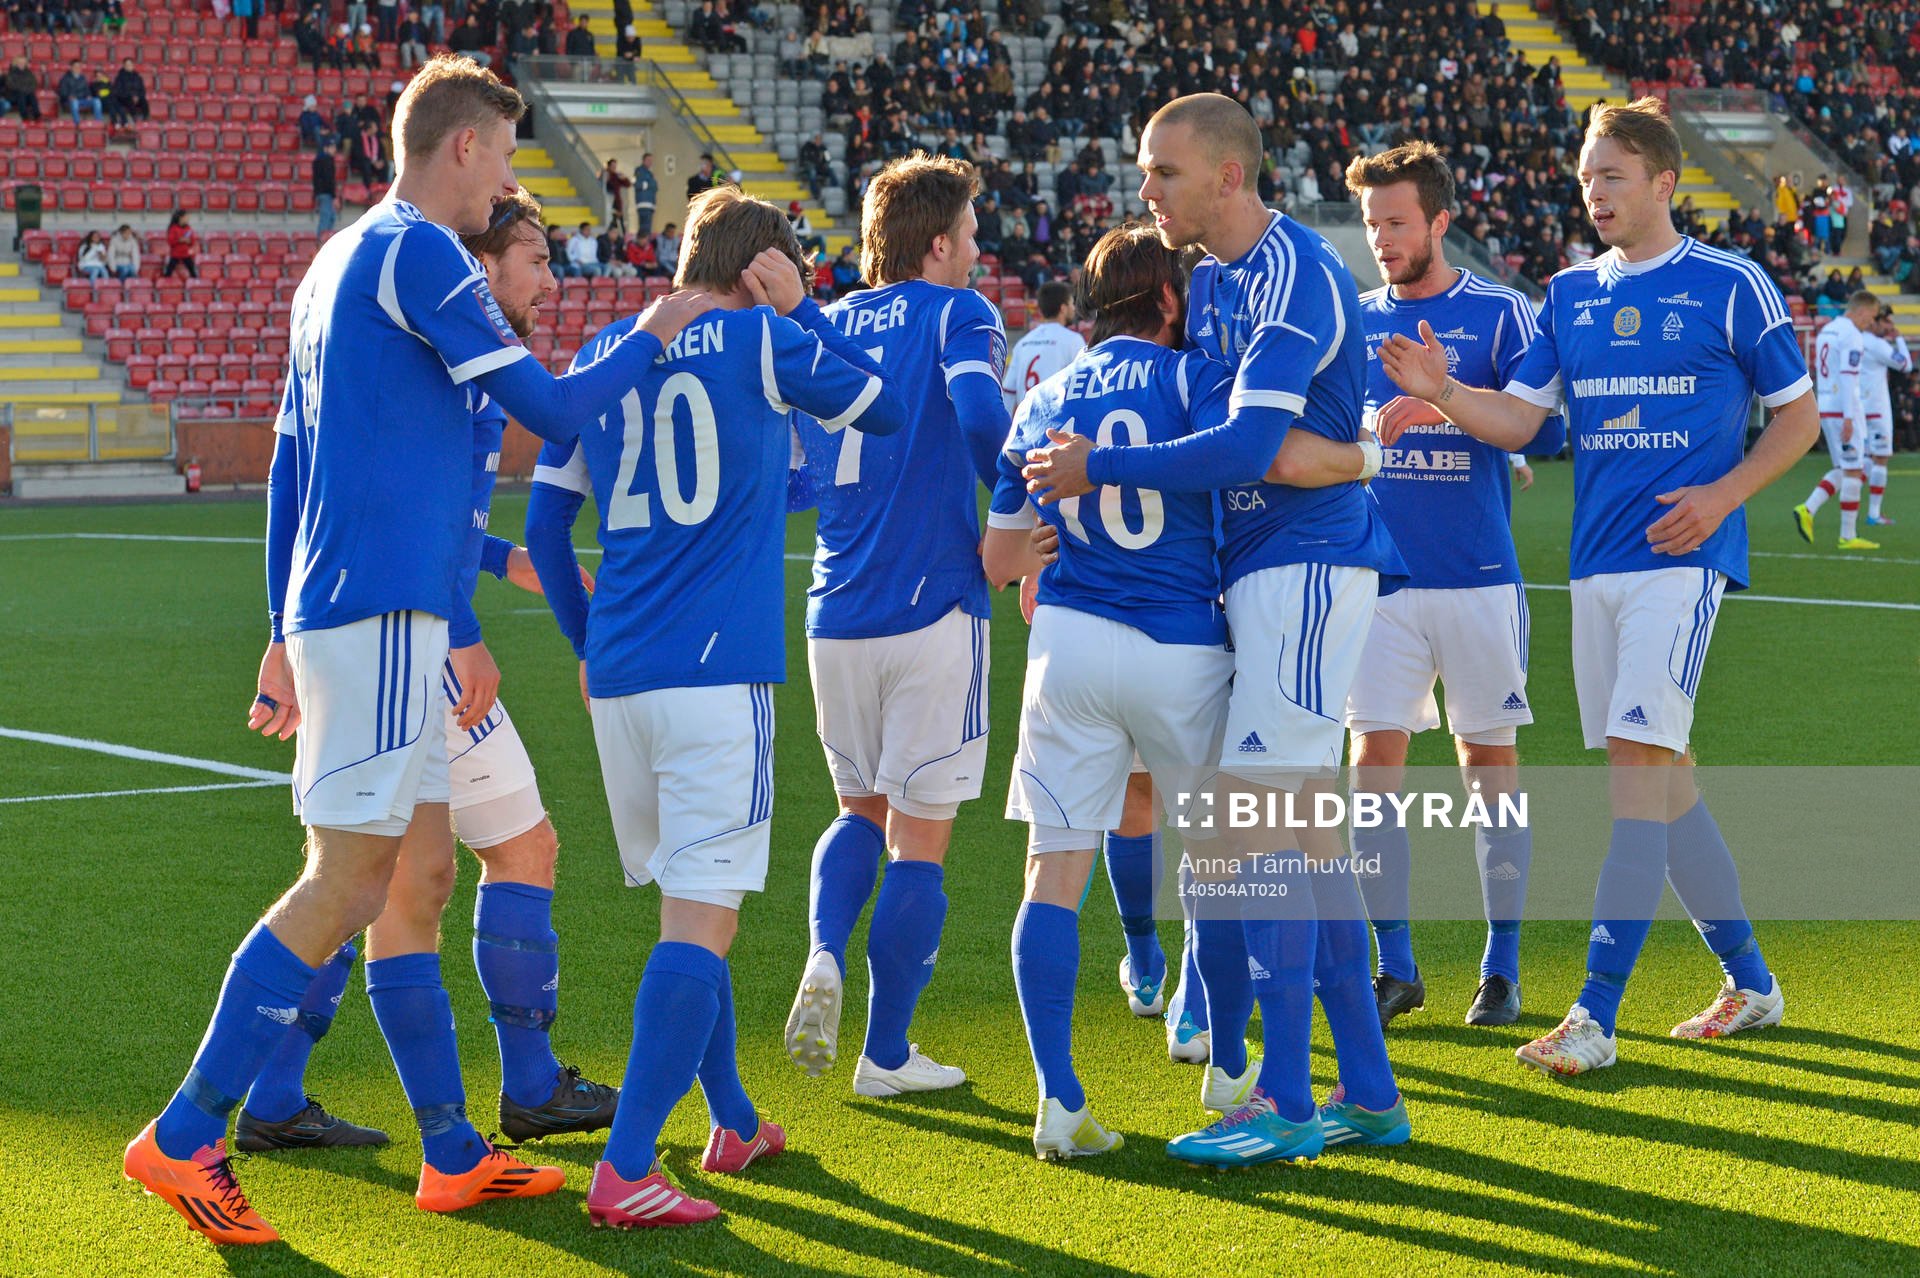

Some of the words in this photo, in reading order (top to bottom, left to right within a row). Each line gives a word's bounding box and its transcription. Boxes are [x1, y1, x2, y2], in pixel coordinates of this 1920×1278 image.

[1657, 297, 1703, 308] NORRPORTEN
[1662, 333, 1681, 341] SCA
[1821, 343, 1829, 379] 8
[1025, 353, 1041, 392] 6
[1062, 359, 1153, 401] ELLIN
[1572, 376, 1697, 398] NORRLANDSLAGET
[1580, 430, 1689, 451] NORRPORTEN
[598, 372, 720, 531] 20
[1383, 448, 1458, 471] EAB
[1387, 472, 1470, 482] SAMHÄLLSBYGGARE
[1227, 490, 1266, 511] SCA
[1621, 715, 1648, 726] adidas
